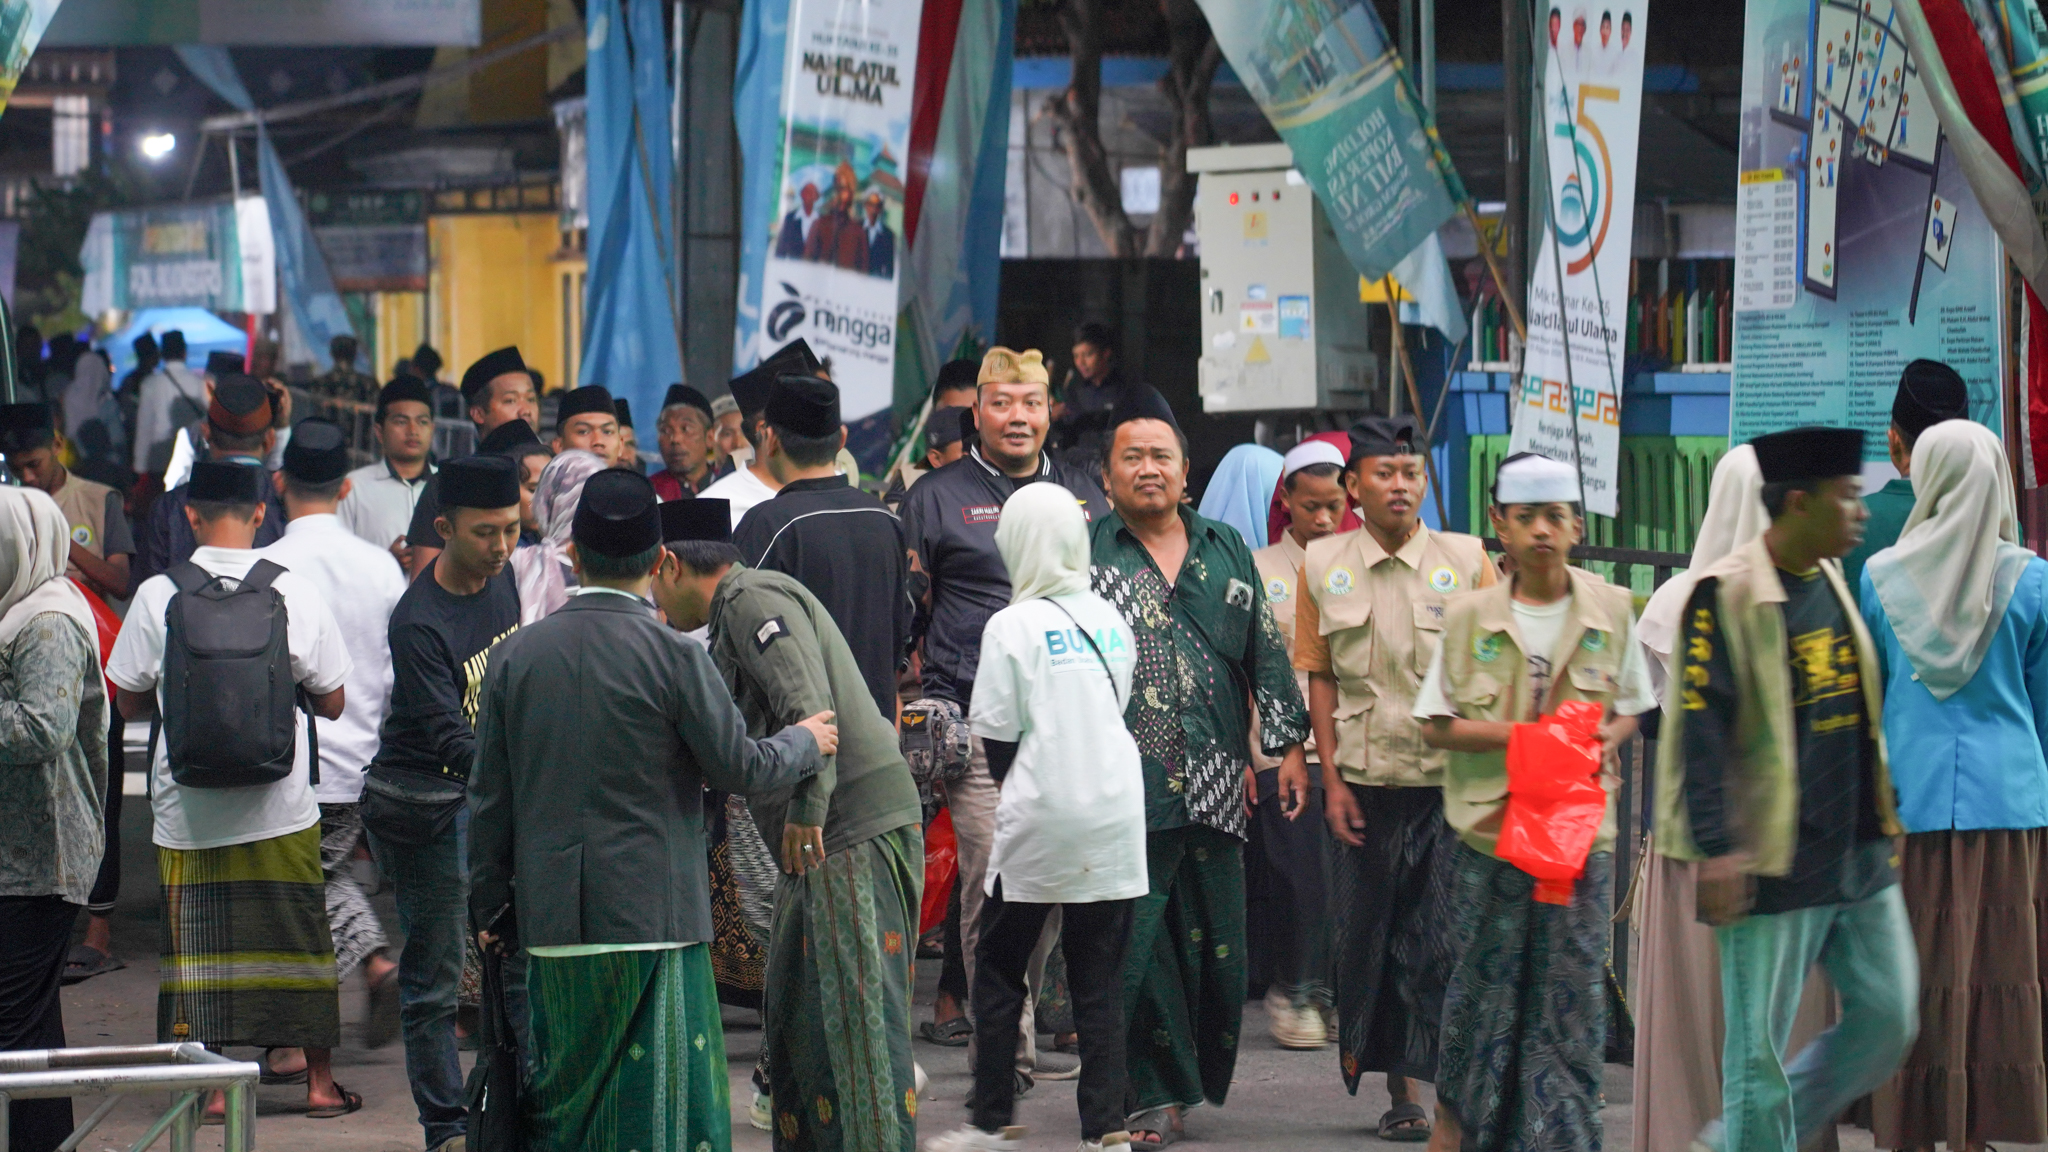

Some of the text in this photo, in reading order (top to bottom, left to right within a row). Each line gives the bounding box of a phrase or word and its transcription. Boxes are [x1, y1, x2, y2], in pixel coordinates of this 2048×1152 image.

[803, 51, 899, 87] NAHLATUL
[816, 73, 882, 106] ULMA
[1581, 295, 1611, 317] Ke-5
[814, 309, 891, 348] mngga
[1045, 628, 1126, 655] BUMA
